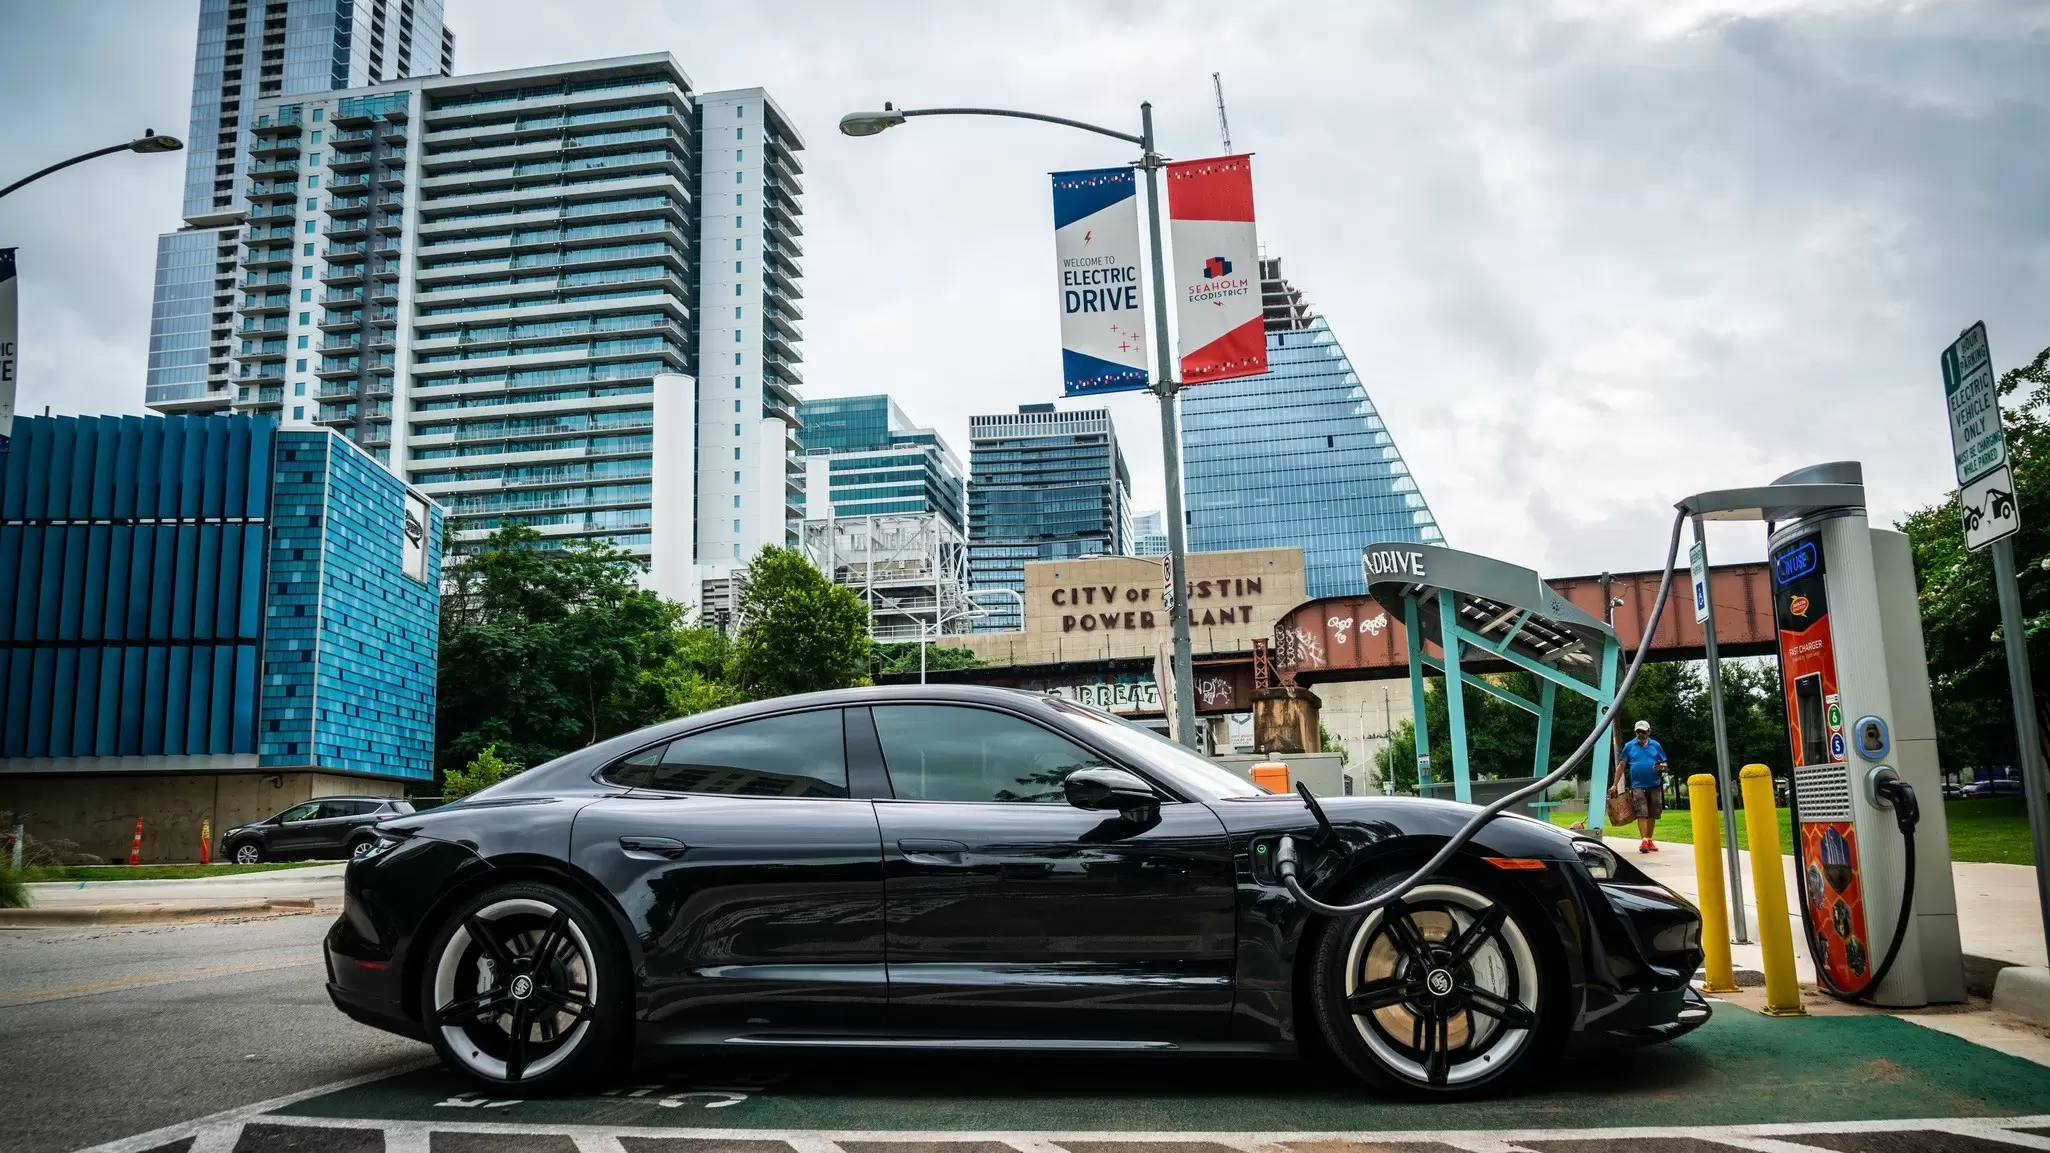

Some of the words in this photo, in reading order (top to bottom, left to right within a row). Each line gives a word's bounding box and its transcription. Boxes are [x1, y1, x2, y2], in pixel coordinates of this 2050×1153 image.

[1063, 256, 1102, 267] WELCOME
[1105, 255, 1115, 265] TO
[1064, 266, 1136, 286] ELECTRIC
[1188, 279, 1248, 294] SEAHOLM
[1065, 285, 1138, 314] DRIVE
[1189, 287, 1248, 302] ECODISTRICT
[1961, 331, 1978, 354] HOUR
[1959, 345, 1987, 374] PARKING
[1951, 373, 1989, 411] ELECTRIC
[1955, 392, 1991, 428] VEHICLE
[1964, 416, 1987, 443] ONLY
[1956, 451, 1969, 467] MUST
[1969, 445, 1976, 457] BE
[1977, 430, 2001, 453] CHARGING
[1978, 448, 1998, 468] PARKED
[1372, 551, 1426, 576] DRIVE
[1792, 551, 1807, 571] USE
[1051, 585, 1117, 606] CITY
[1126, 588, 1150, 601] OF
[1063, 611, 1155, 633] POWER
[1170, 605, 1253, 629] LANT
[1789, 646, 1799, 657] FAST
[1799, 639, 1823, 654] CHARGER
[1832, 711, 1838, 723] 6
[1835, 740, 1841, 752] 5
